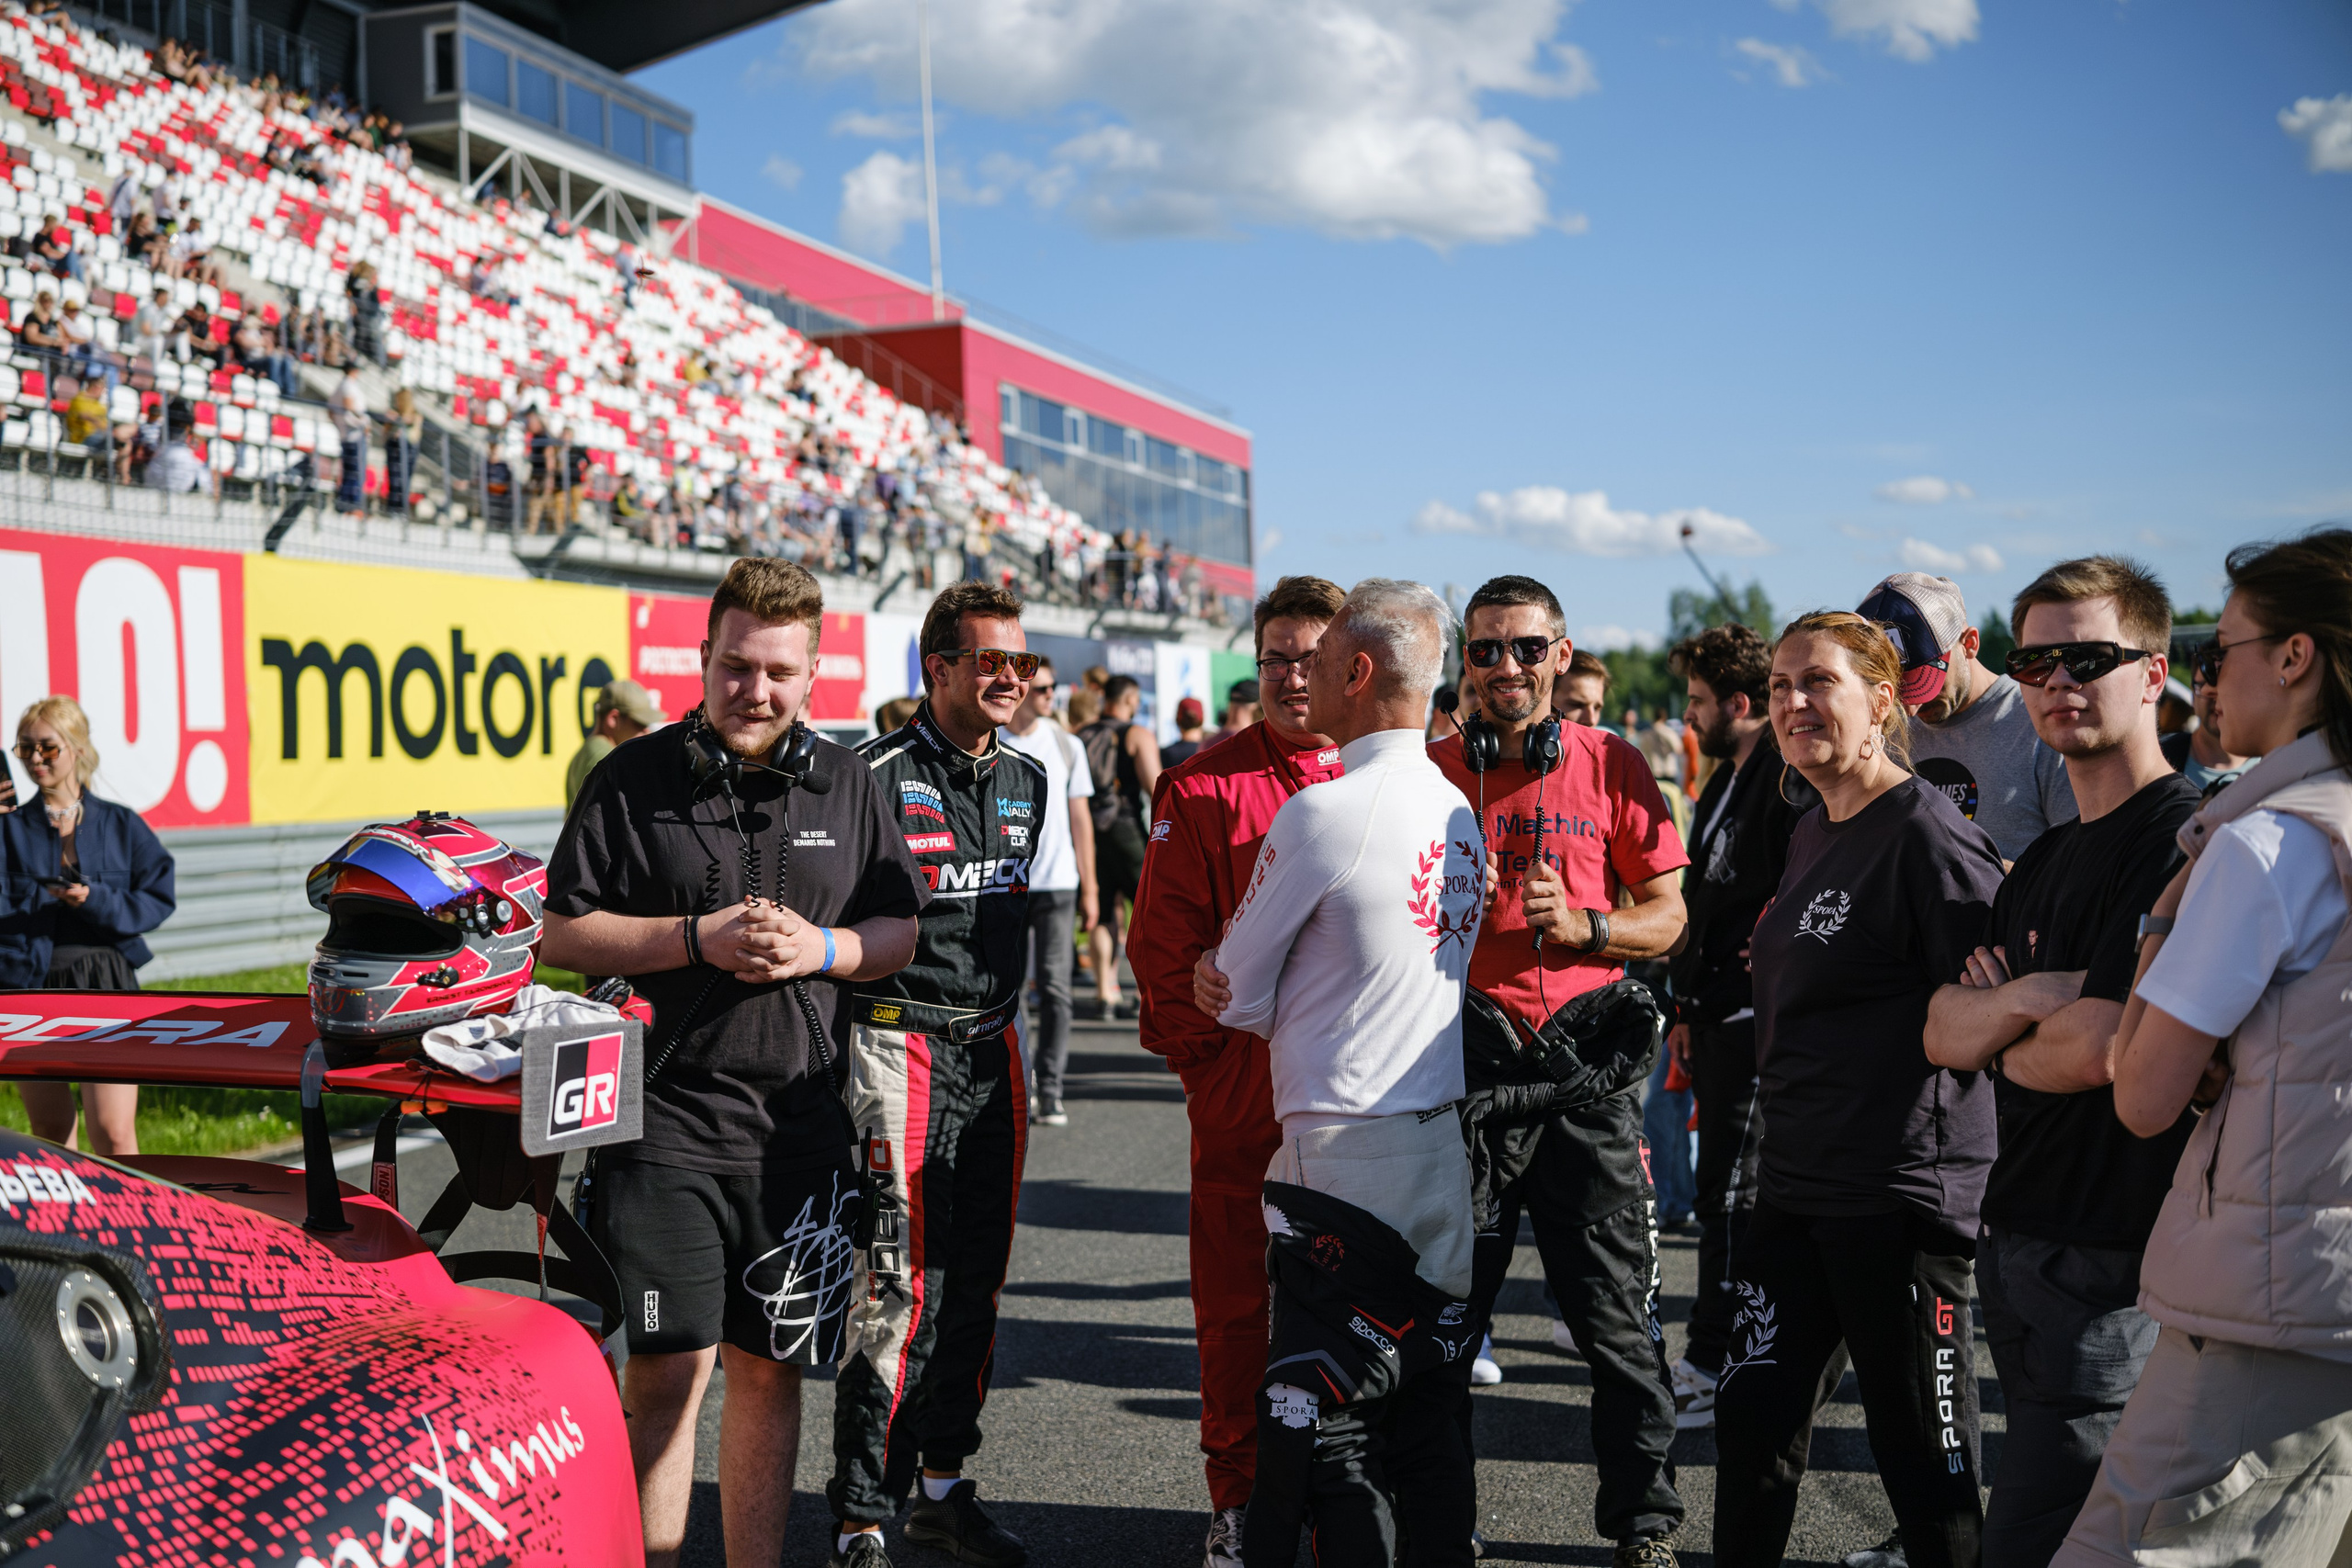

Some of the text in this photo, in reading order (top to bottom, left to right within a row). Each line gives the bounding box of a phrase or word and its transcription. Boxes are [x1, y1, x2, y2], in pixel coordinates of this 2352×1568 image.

[1317, 750, 1340, 763] OMP
[1497, 813, 1595, 837] Machin
[908, 837, 950, 850] MOTUL
[1011, 836, 1026, 846] CUP
[1497, 847, 1560, 873] Teh
[1434, 874, 1476, 897] SPORA
[873, 1007, 900, 1021] OMP
[554, 1072, 616, 1125] GR
[647, 1292, 657, 1329] HUGO
[1351, 1315, 1396, 1355] sparco
[1936, 1297, 1964, 1474] SPORA GT
